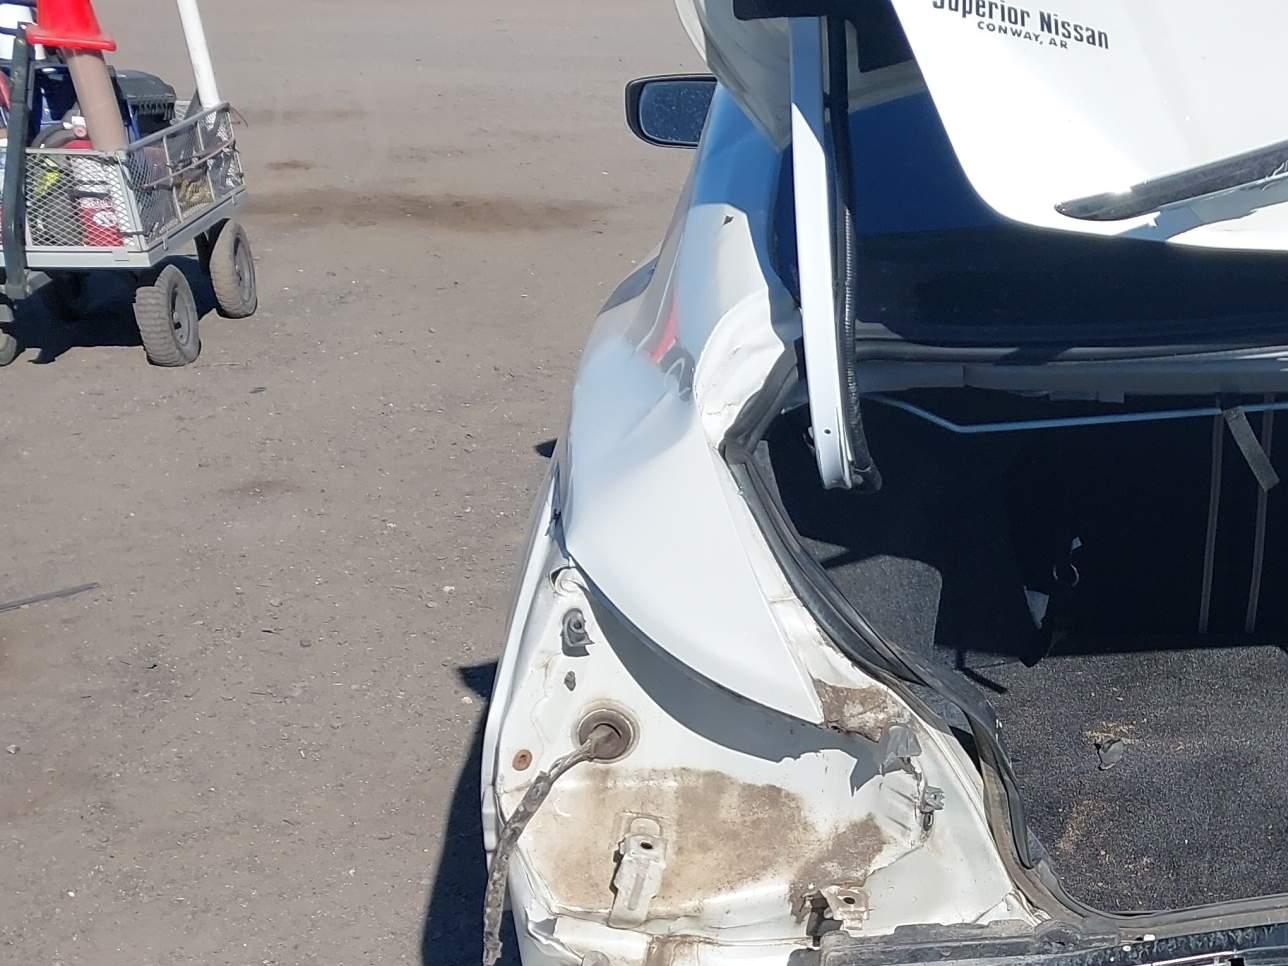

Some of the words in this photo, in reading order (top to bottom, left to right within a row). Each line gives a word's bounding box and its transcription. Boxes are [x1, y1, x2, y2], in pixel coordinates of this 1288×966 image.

[977, 21, 1044, 45] CONWAY,
[1048, 38, 1068, 49] AR
[1039, 10, 1110, 49] Nissan
